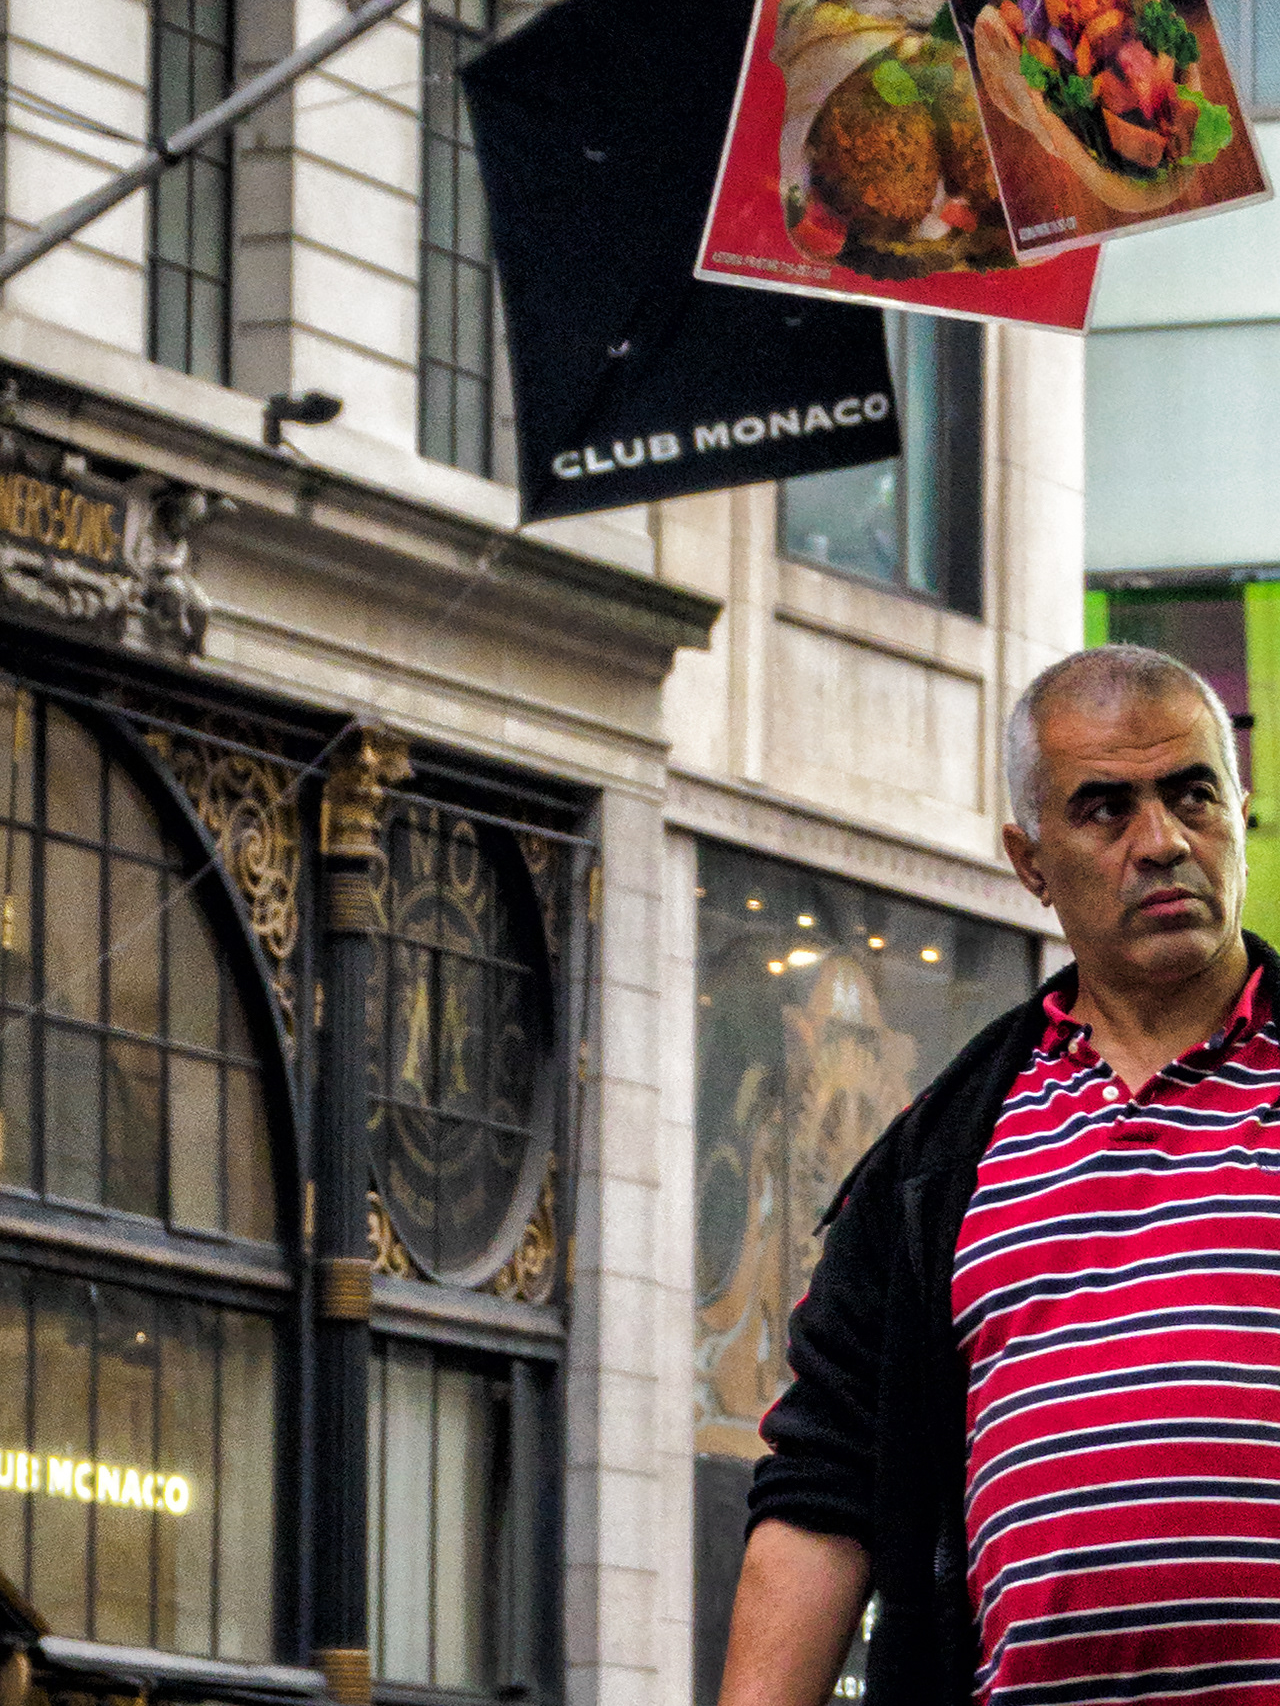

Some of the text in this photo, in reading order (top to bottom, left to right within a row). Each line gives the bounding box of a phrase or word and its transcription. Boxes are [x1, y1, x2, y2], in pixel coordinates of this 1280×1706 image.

[552, 395, 888, 481] CLUB MONACO
[48, 1456, 190, 1514] MONACO
